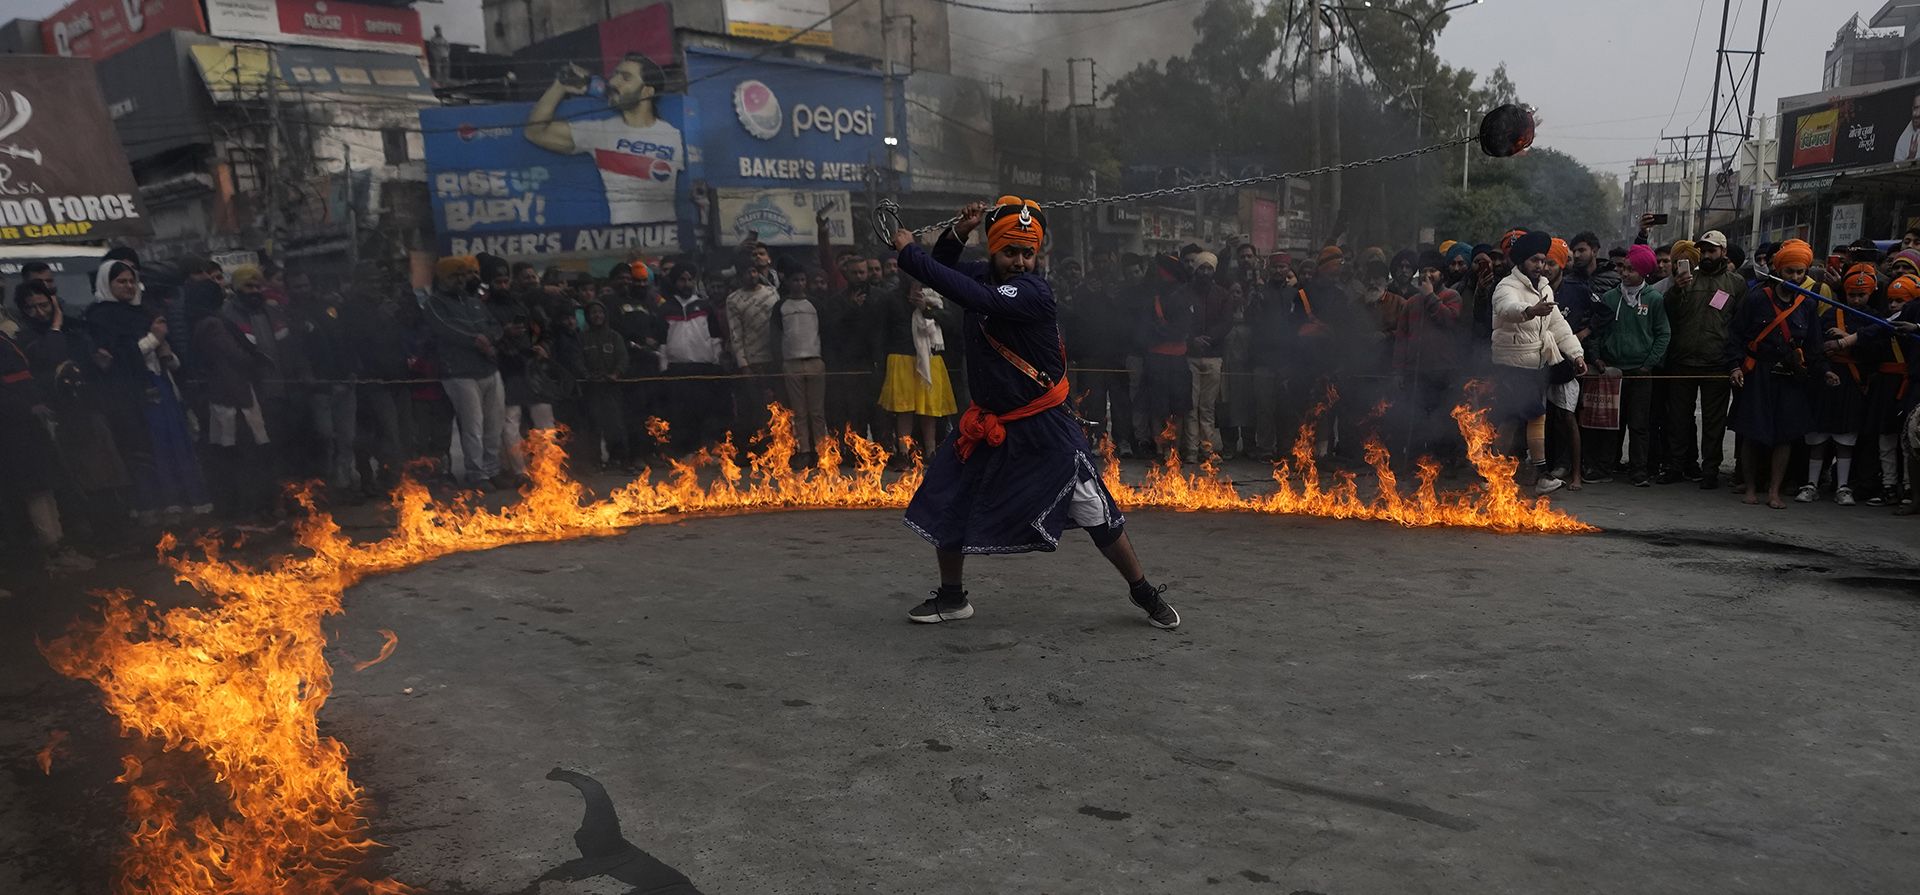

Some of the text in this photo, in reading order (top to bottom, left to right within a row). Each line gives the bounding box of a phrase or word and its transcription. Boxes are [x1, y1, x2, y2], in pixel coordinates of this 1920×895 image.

[793, 104, 874, 141] pepsi
[617, 138, 675, 161] PEPSI
[436, 169, 510, 198] RISE
[739, 157, 882, 182] BAKER'S AVEN
[48, 193, 140, 223] FORCE
[444, 192, 546, 231] BABY!
[23, 221, 93, 238] CAMP
[451, 224, 680, 257] BAKER'S AVENUE
